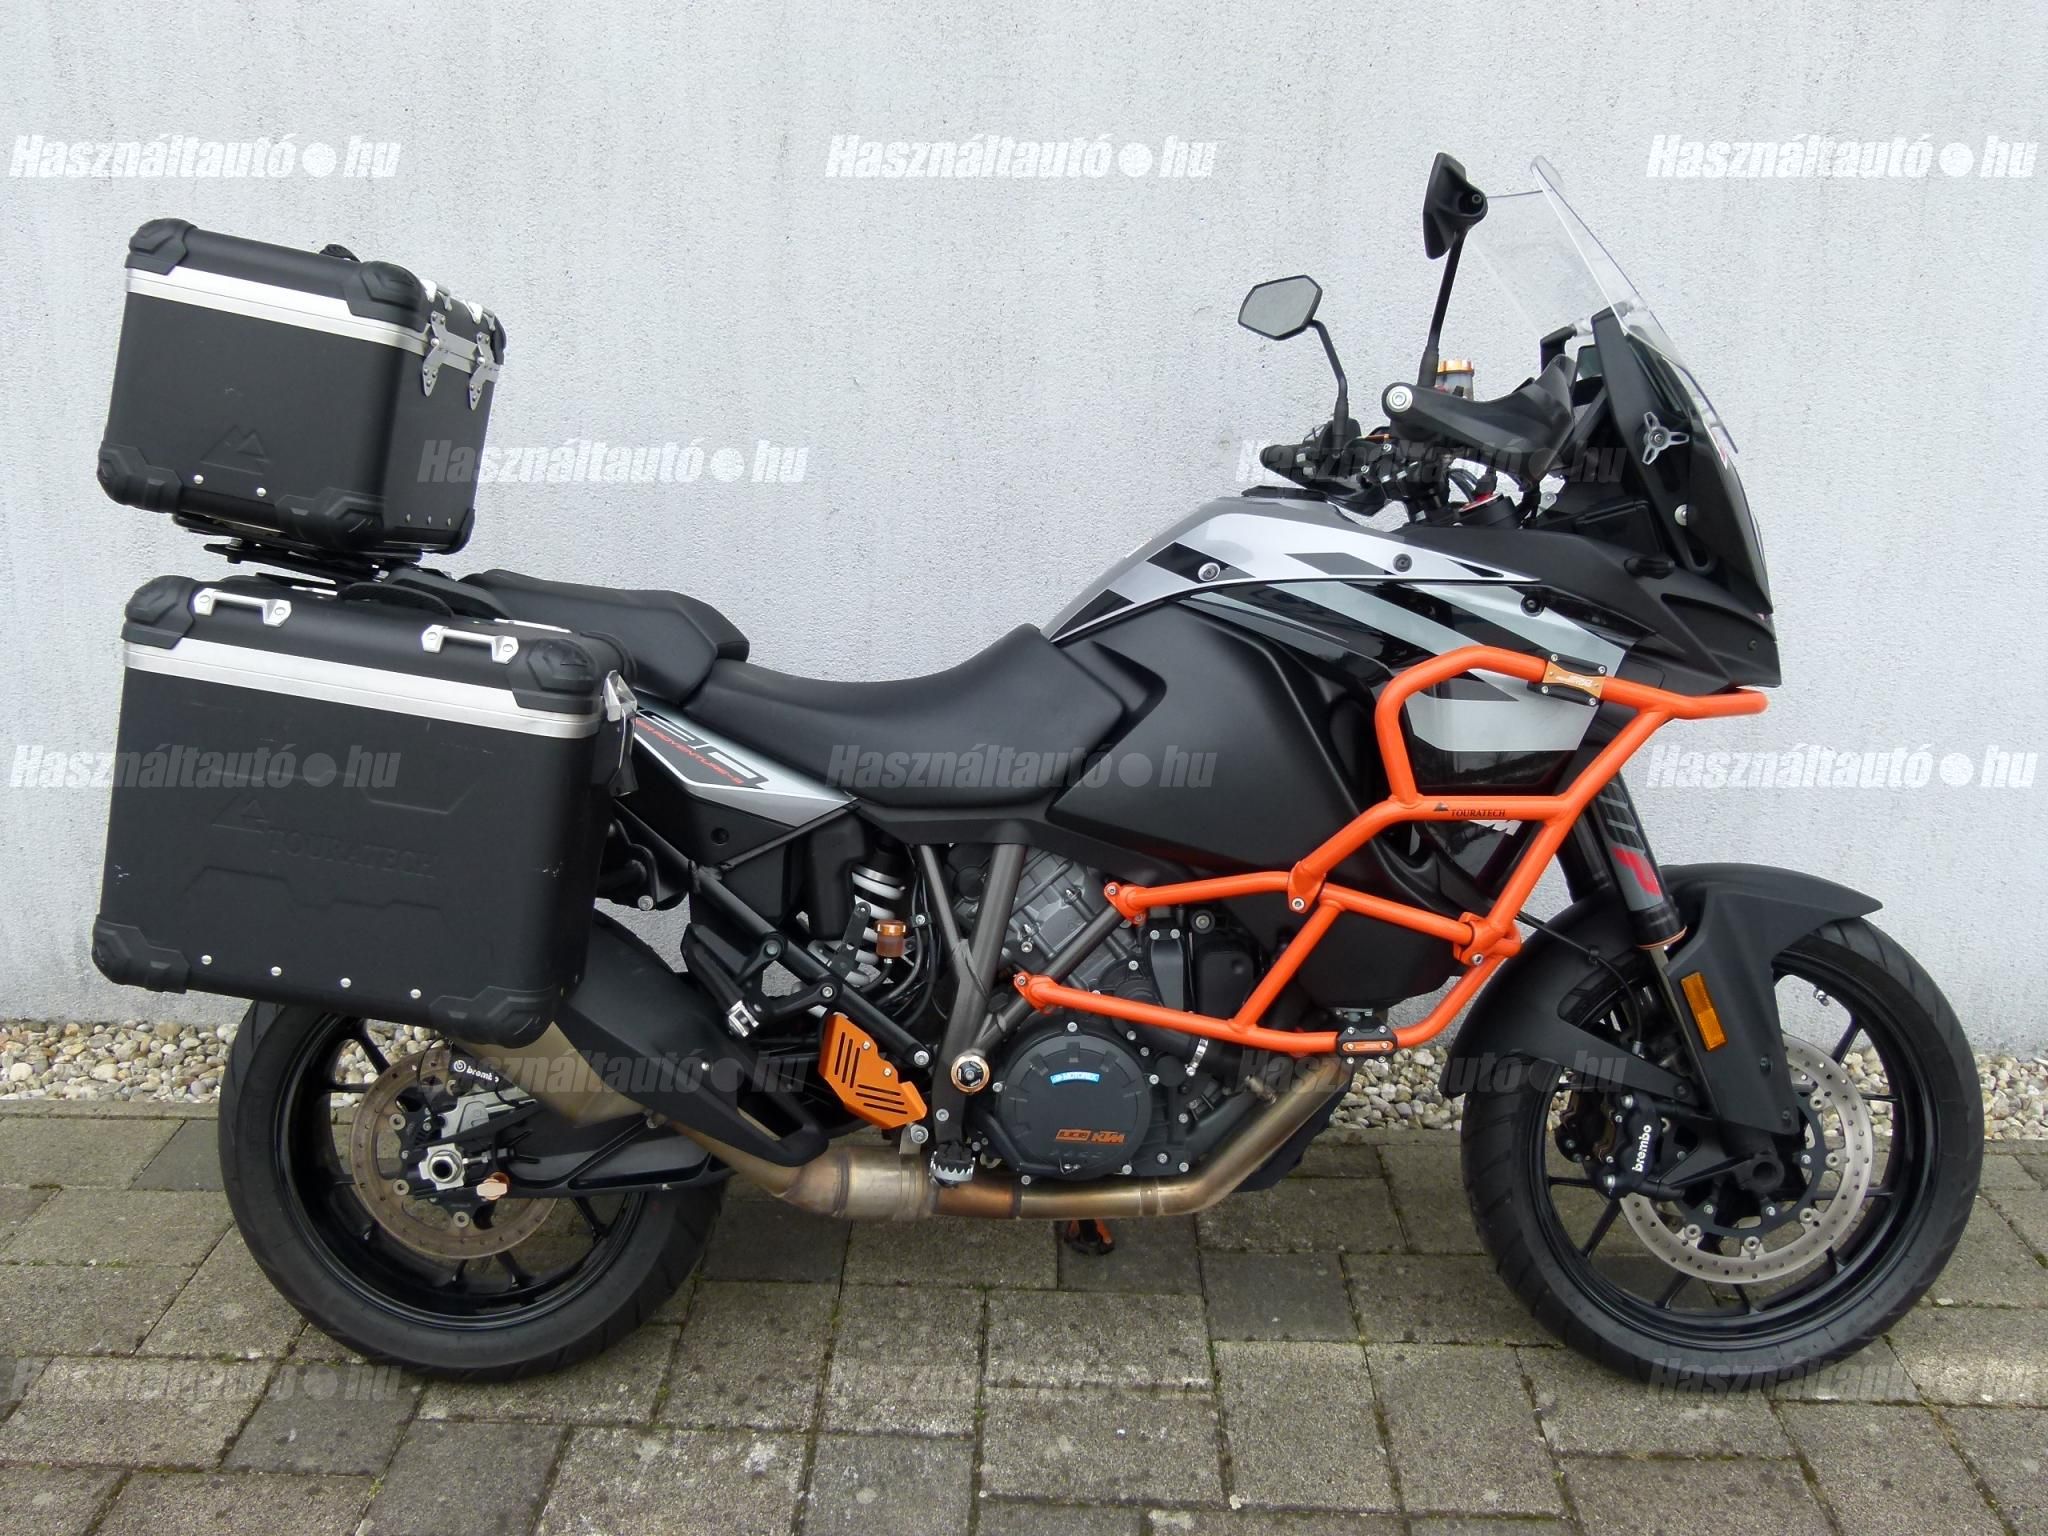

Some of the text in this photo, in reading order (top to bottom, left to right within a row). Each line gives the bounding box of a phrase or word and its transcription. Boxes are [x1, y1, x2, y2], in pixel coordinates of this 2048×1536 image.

[1451, 808, 1506, 818] TOURATECH
[1091, 1130, 1125, 1144] KTM
[1631, 1124, 1652, 1173] brembo
